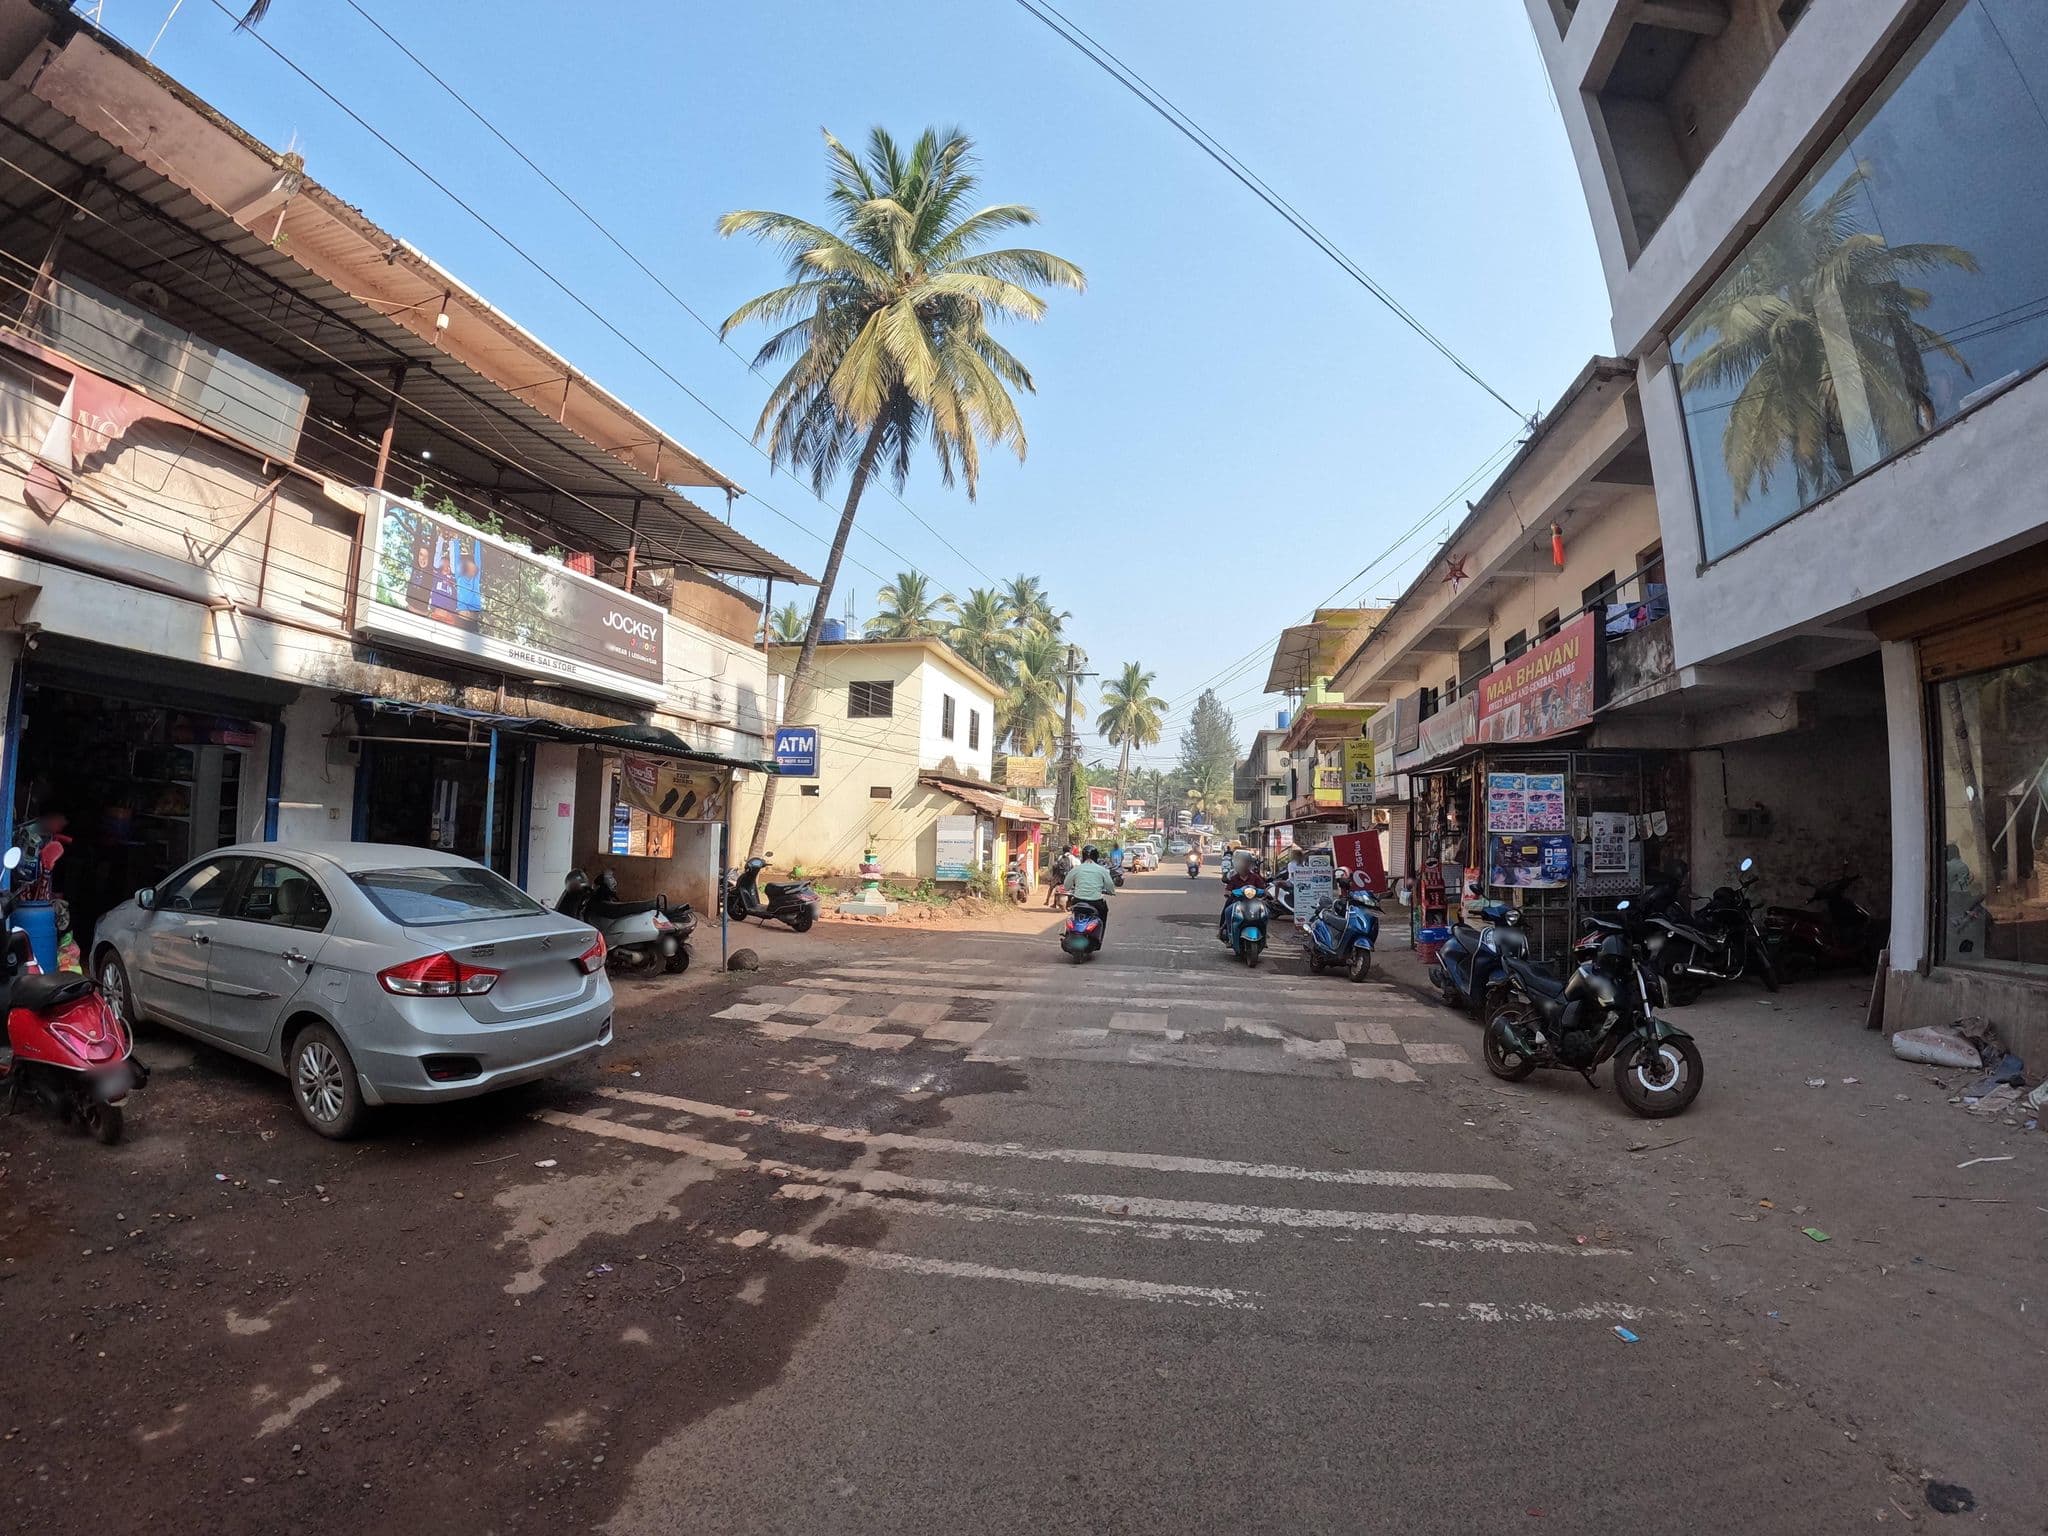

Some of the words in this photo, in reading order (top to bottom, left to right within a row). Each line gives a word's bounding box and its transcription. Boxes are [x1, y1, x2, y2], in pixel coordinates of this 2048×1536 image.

[602, 611, 658, 642] JOCKEY
[508, 648, 536, 663] SHREE
[551, 661, 577, 674] STORE
[1486, 675, 1513, 702] MAA
[1516, 636, 1581, 687] BHAVANI
[1504, 690, 1518, 706] MART
[1518, 684, 1530, 698] AND
[1555, 661, 1576, 680] STORE
[777, 736, 814, 753] ATM
